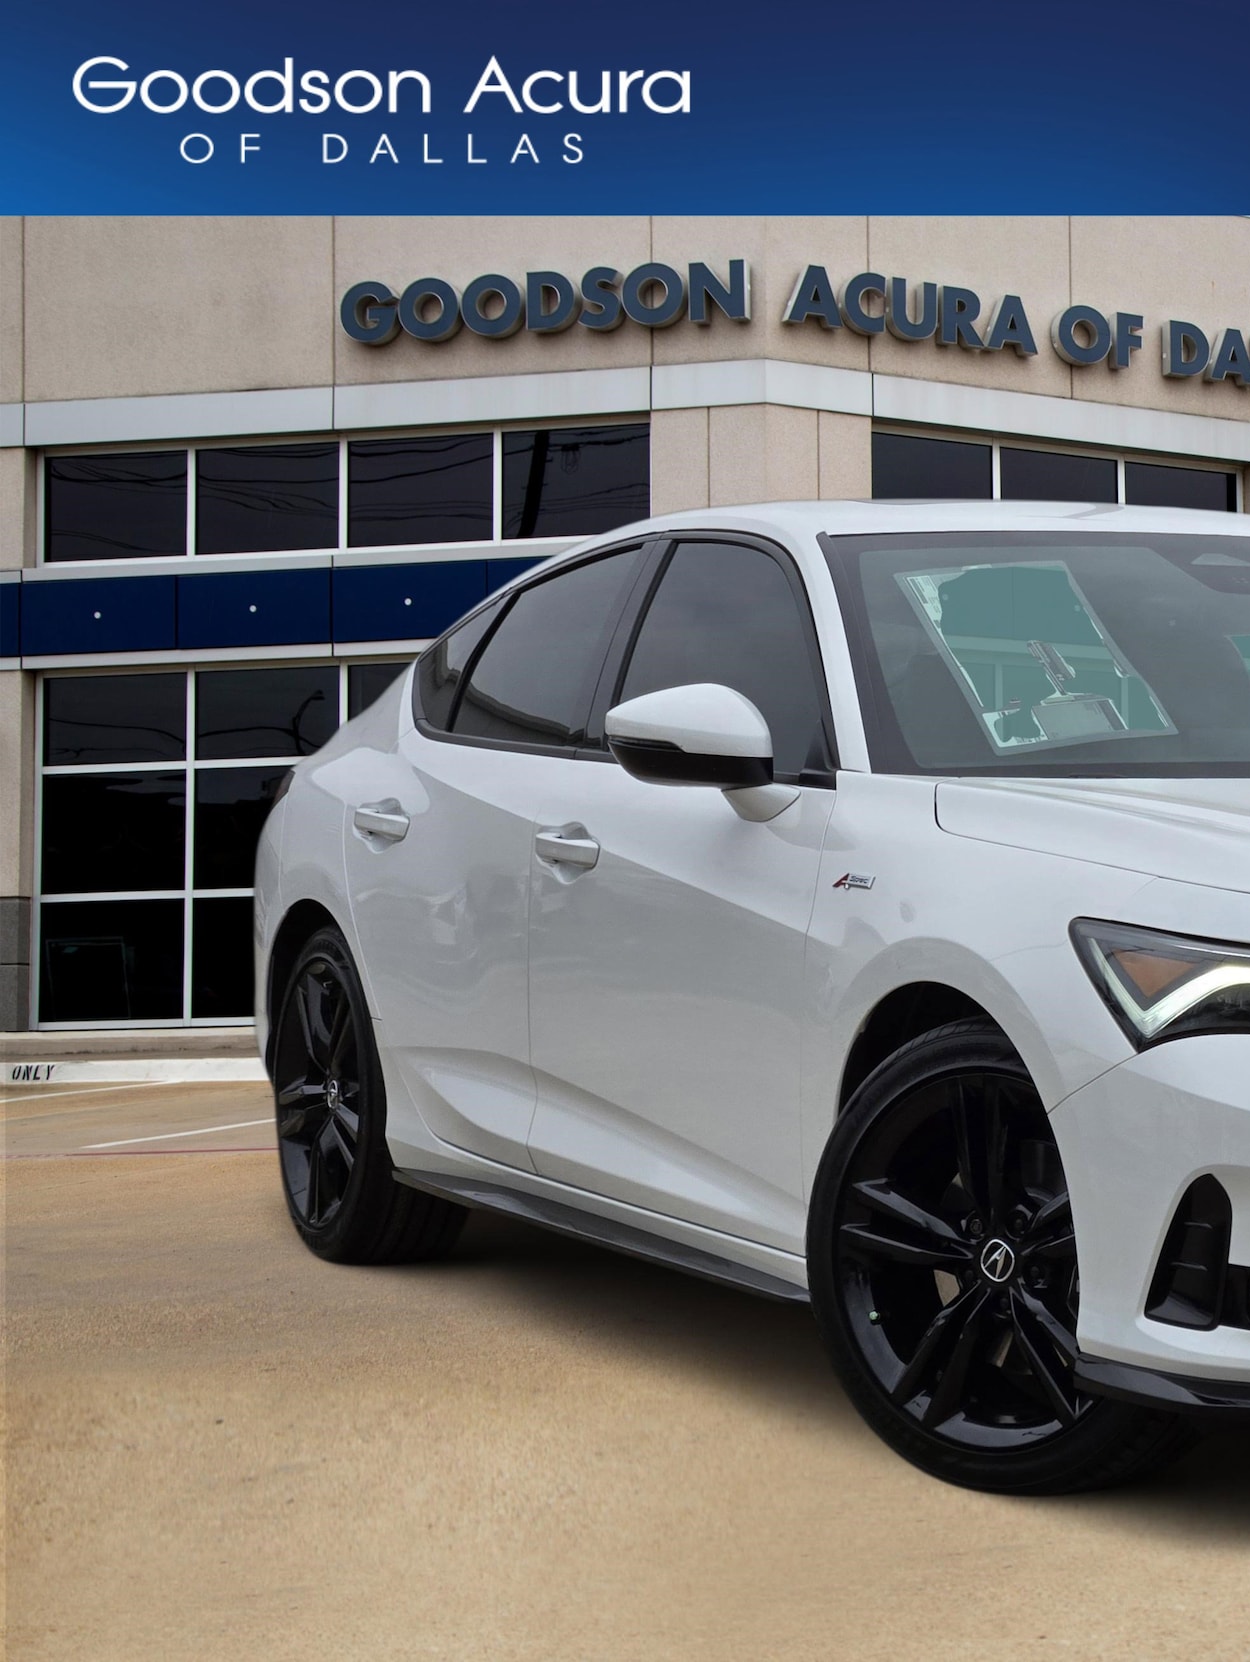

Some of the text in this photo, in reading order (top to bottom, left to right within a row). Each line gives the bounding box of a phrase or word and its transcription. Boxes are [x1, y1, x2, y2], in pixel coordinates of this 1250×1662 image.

[340, 258, 751, 348] GOODSON
[783, 264, 1039, 357] ACURA
[1051, 304, 1144, 369] OF
[12, 1064, 55, 1081] ONLY
